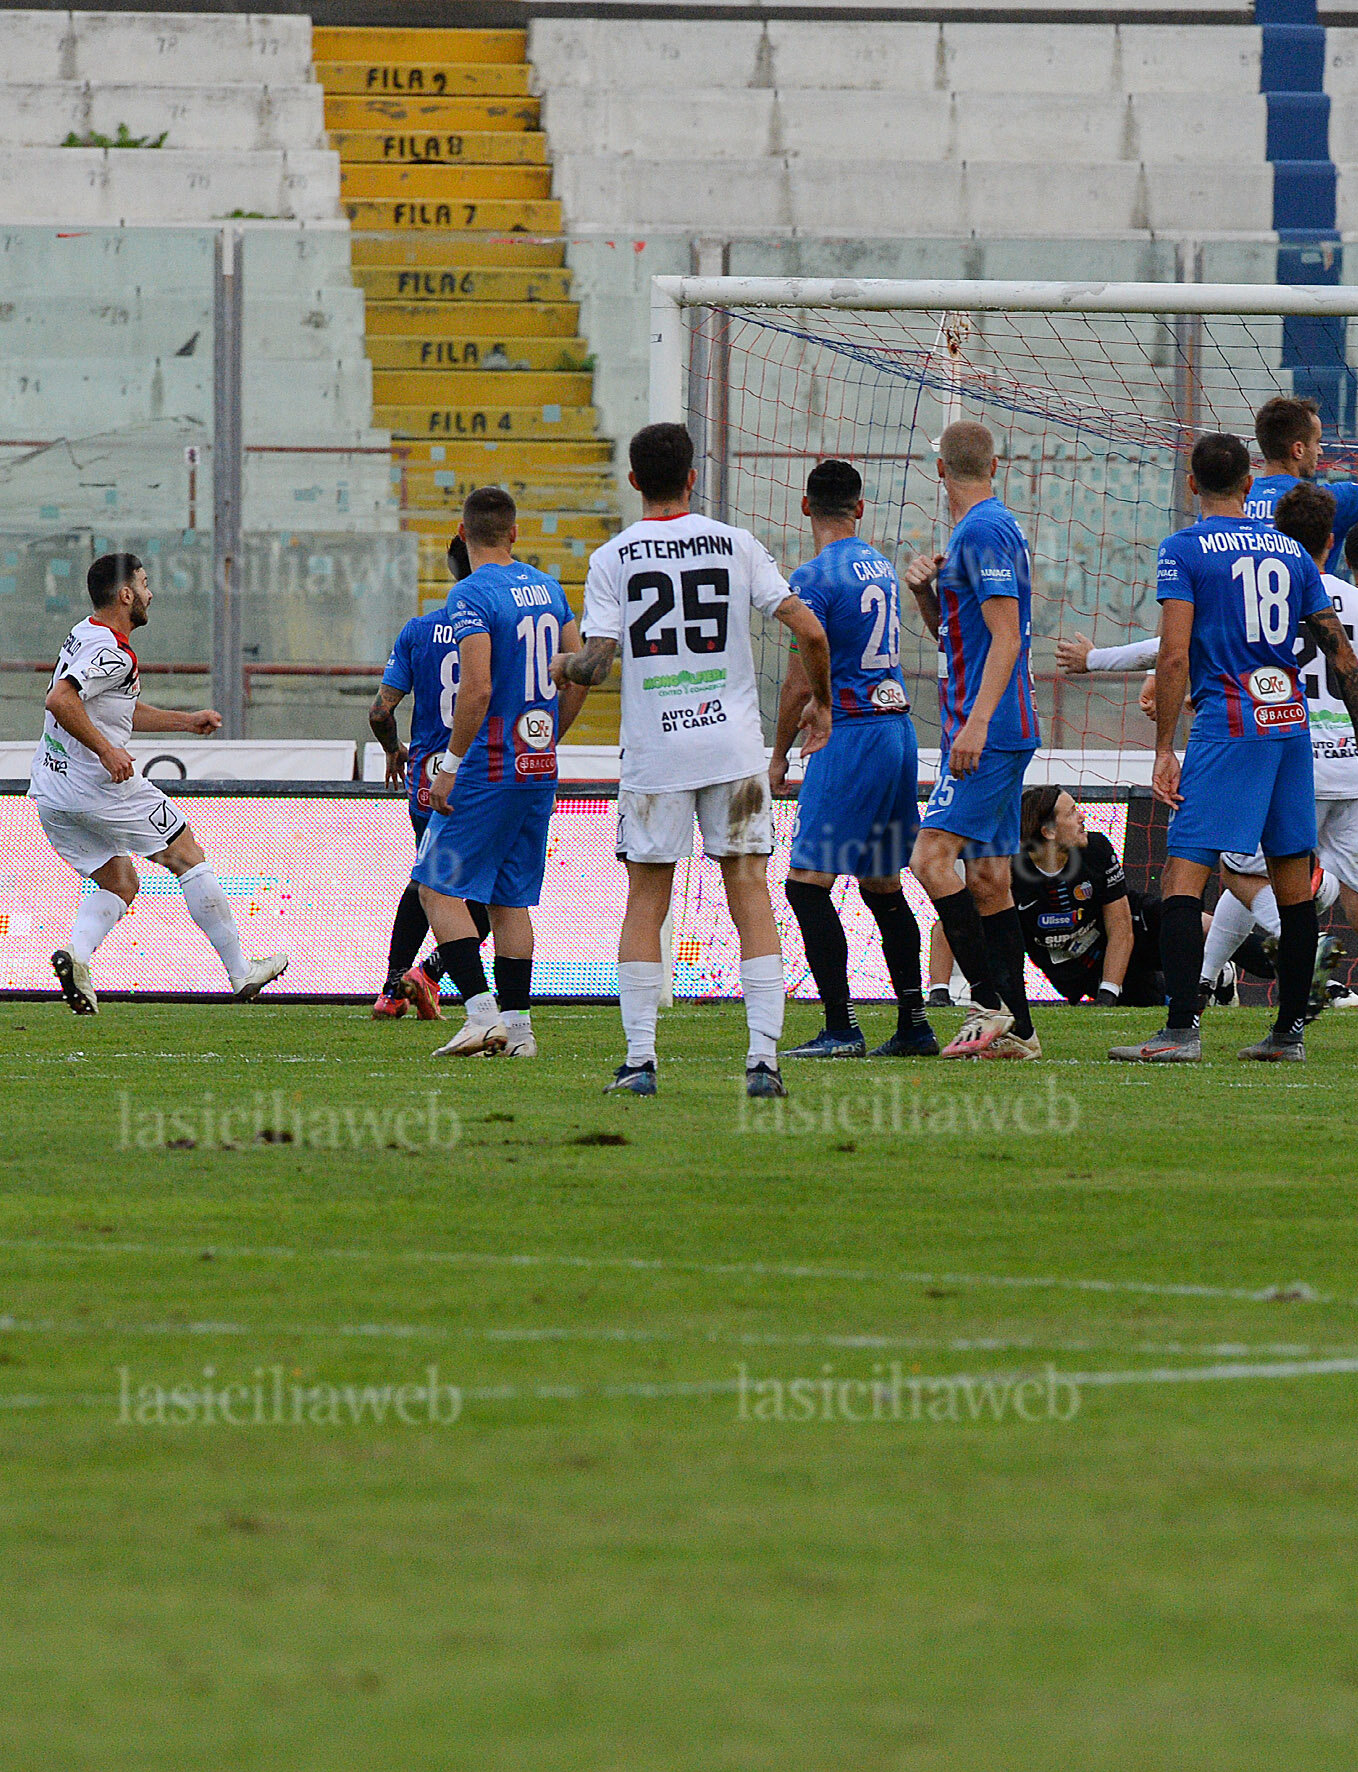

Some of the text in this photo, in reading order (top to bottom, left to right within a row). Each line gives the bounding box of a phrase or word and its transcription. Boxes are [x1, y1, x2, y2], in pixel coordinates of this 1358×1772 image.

[366, 68, 448, 93] FILA 9
[384, 136, 463, 158] FILA 8
[394, 204, 478, 225] FILA 7
[399, 272, 476, 294] FILA 6
[421, 342, 478, 364] FILA
[429, 412, 511, 434] FILA 4
[618, 535, 733, 565] PETERMANN
[1199, 531, 1302, 558] MONTEAGUDO
[511, 584, 553, 608] BIONDI
[1231, 556, 1291, 645] 18
[627, 567, 730, 658] 25
[861, 584, 900, 670] 26
[517, 612, 559, 702] 10
[661, 709, 694, 721] AUTO
[662, 713, 727, 732] DI CARLO
[1269, 708, 1303, 720] BACCO
[1313, 741, 1334, 749] UTO
[1041, 916, 1071, 925] Ulisse
